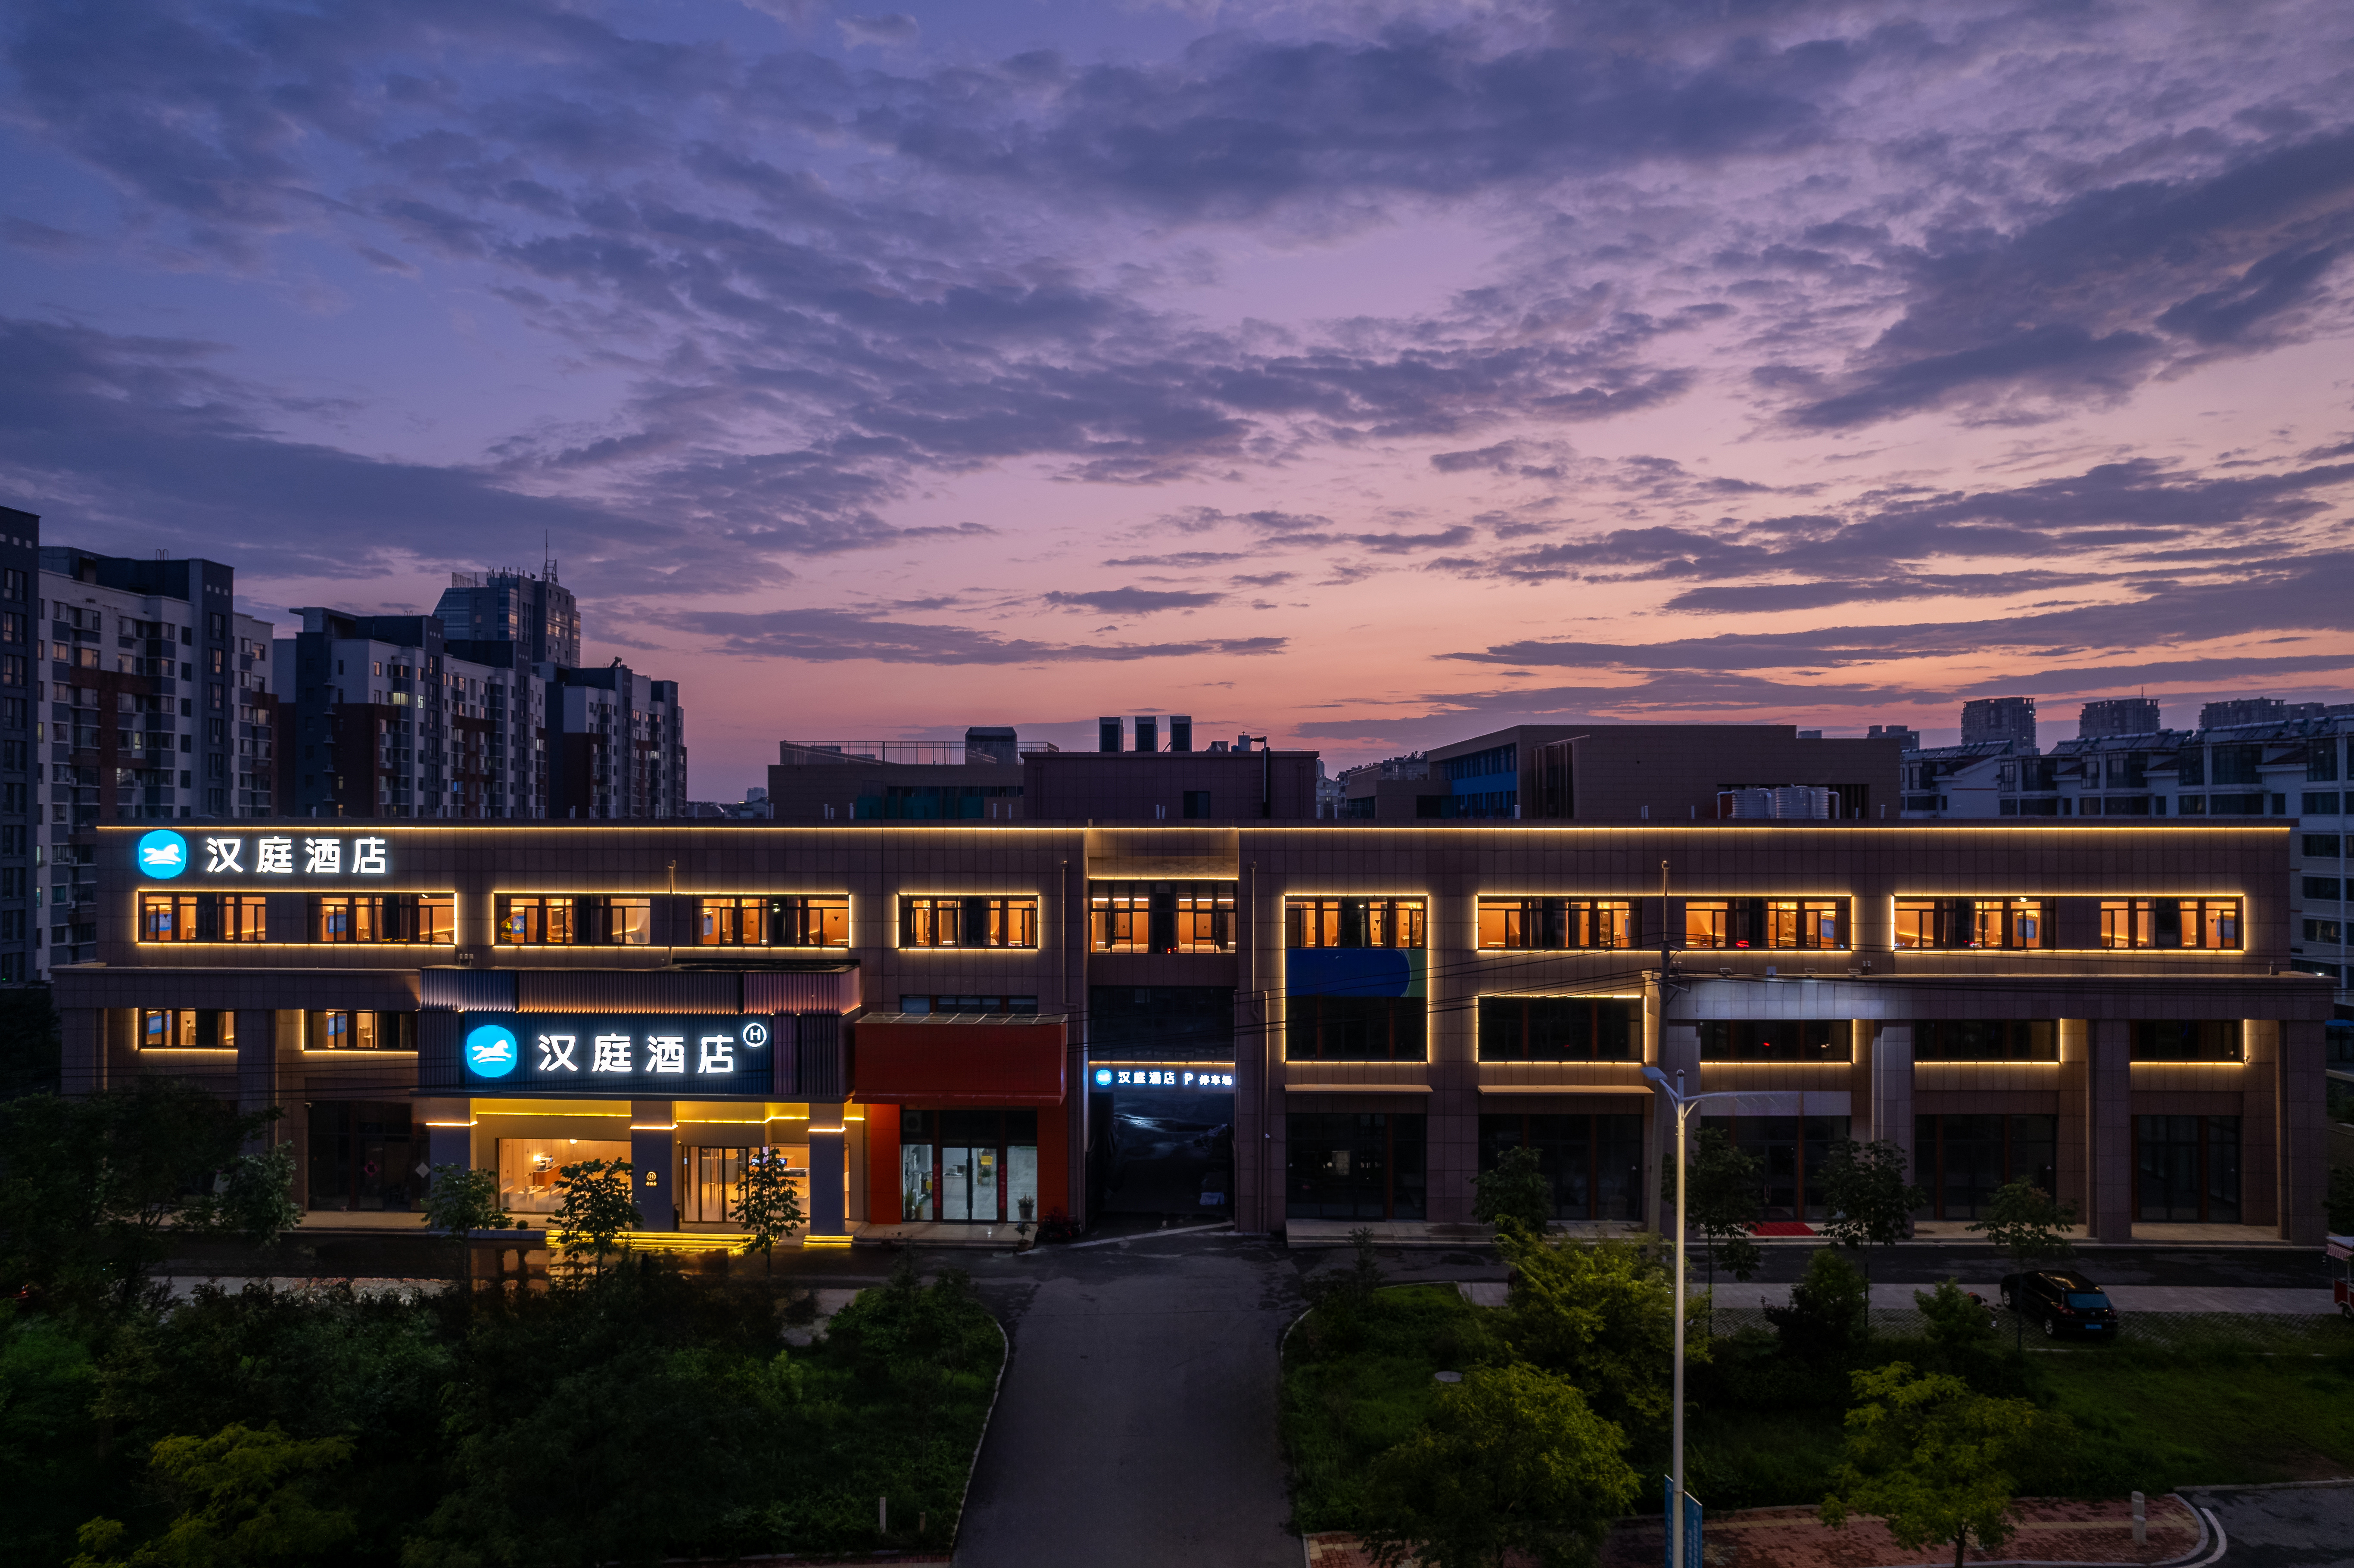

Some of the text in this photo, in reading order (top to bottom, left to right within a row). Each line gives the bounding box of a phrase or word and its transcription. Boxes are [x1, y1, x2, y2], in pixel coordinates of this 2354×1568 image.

[206, 836, 386, 874] 汉庭酒店
[538, 1033, 734, 1073] 汉庭酒店
[1118, 1071, 1232, 1086] 汉庭酒店 P 停车场
